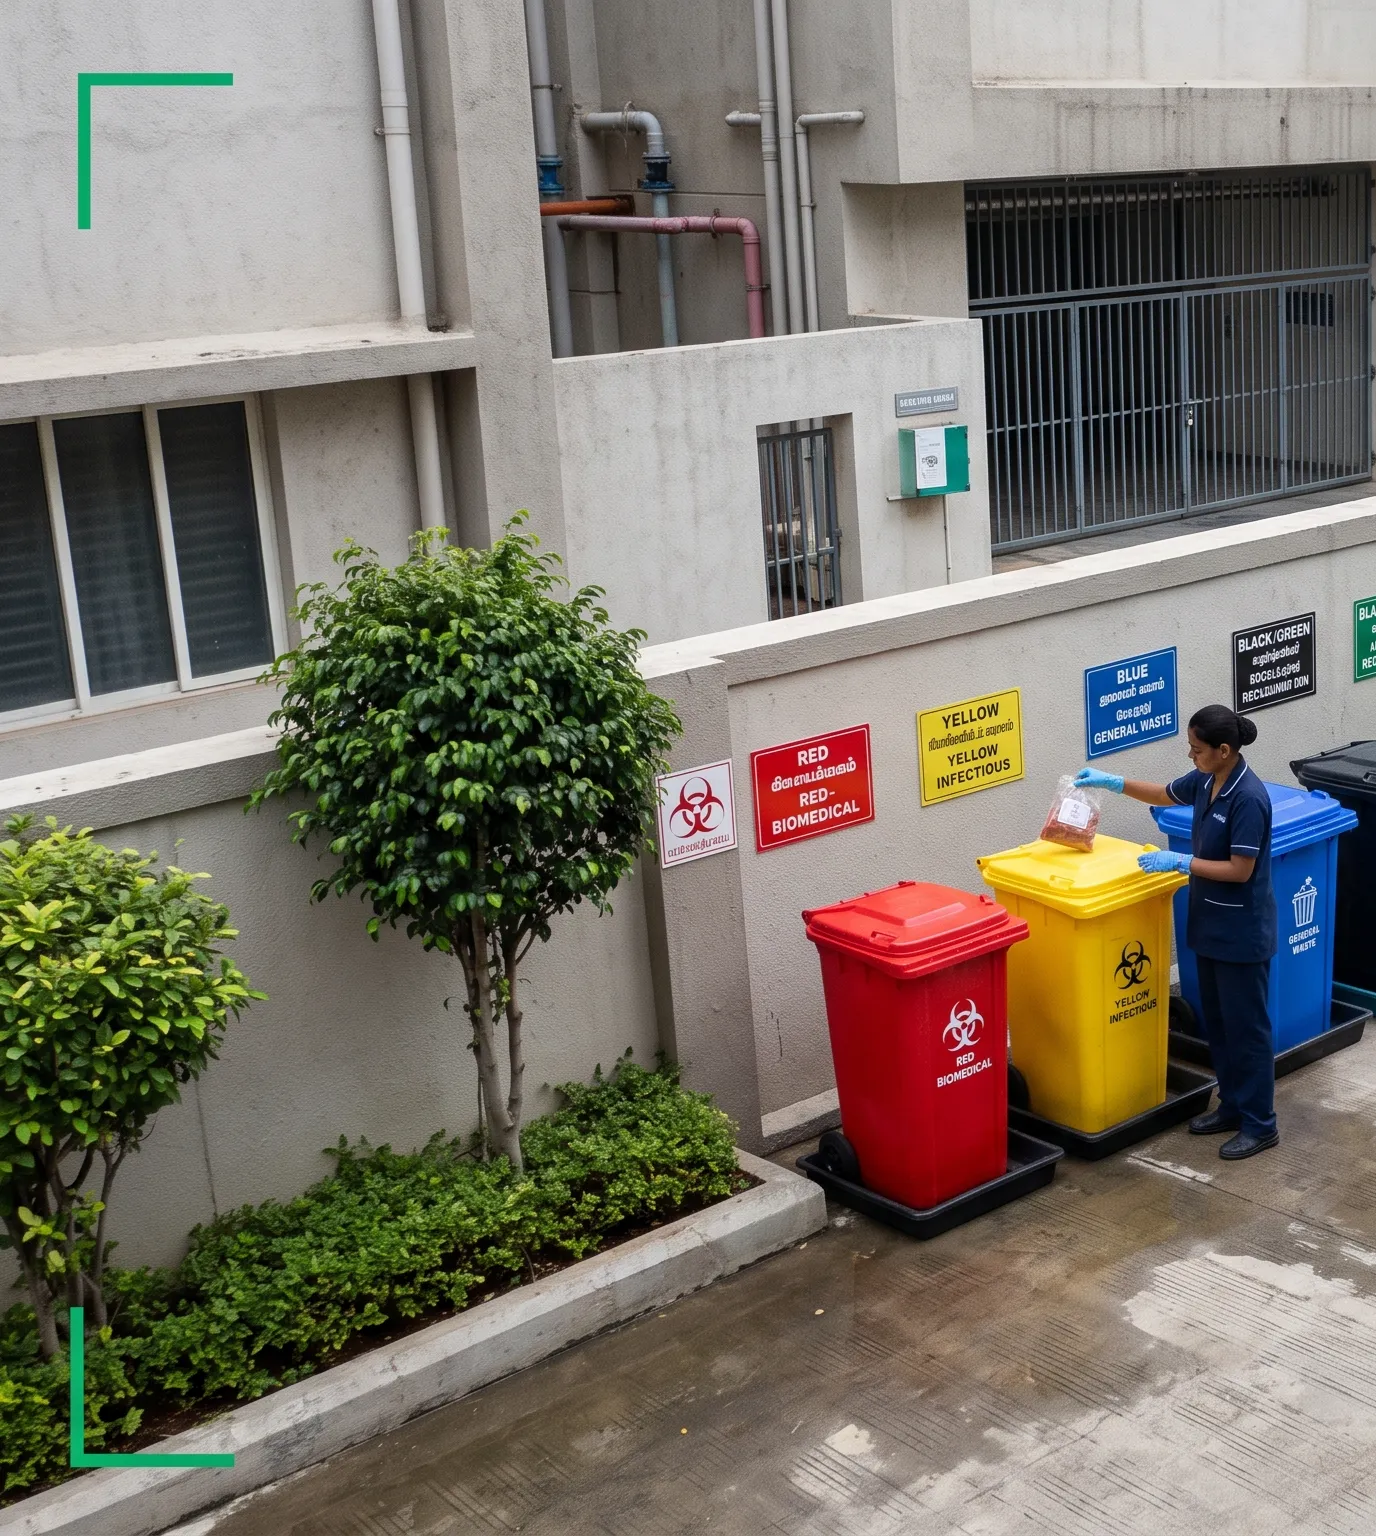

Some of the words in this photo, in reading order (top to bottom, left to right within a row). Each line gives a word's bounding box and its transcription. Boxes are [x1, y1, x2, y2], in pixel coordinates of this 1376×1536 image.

[1238, 621, 1310, 653] BLACK/GREEN
[1117, 663, 1149, 684] BLUE
[941, 702, 999, 729] YELLOW
[1094, 722, 1138, 745] GENERAL
[1140, 712, 1172, 732] WASTE
[797, 745, 829, 766] RED
[947, 743, 998, 767] YELLOW
[937, 758, 1011, 789] INFECTIOUS
[799, 788, 836, 807] RED-
[772, 800, 860, 835] BIOMEDICAL
[1109, 998, 1157, 1024] INFECTIOUS
[956, 1051, 975, 1067] RED
[936, 1057, 993, 1088] BIOMEDICAL
